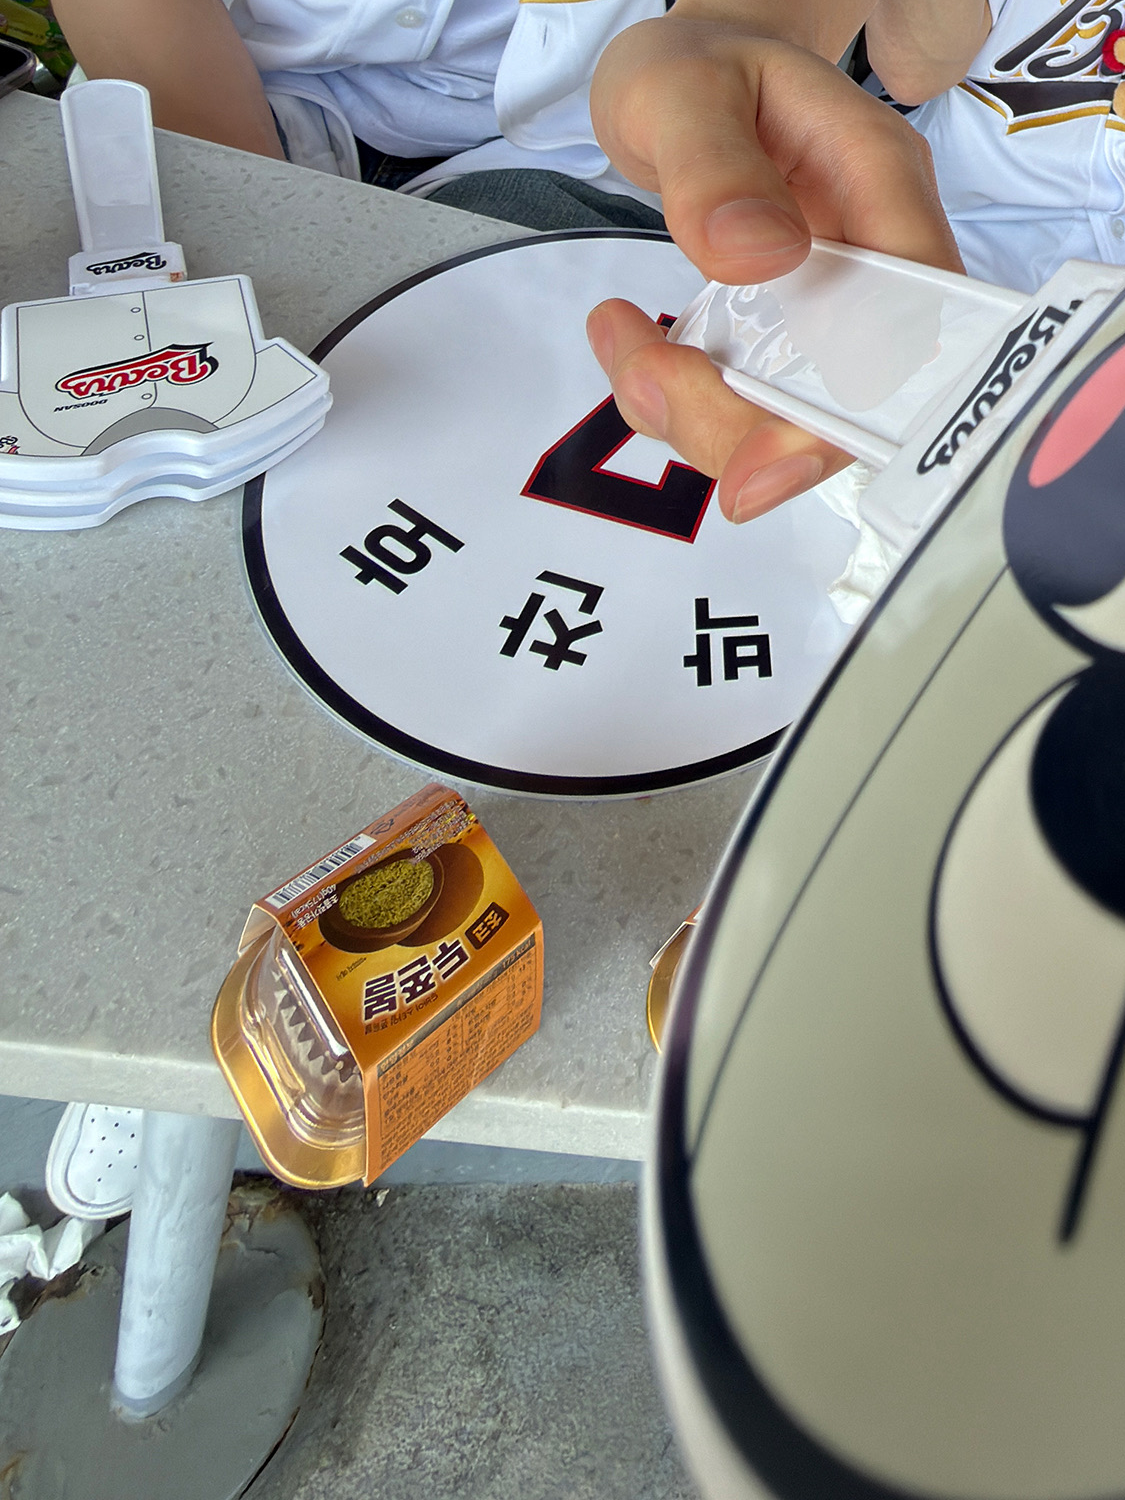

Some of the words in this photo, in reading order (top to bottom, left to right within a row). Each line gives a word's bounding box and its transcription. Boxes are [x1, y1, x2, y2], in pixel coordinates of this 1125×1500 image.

[86, 252, 168, 276] Bears
[55, 342, 219, 400] Bears
[53, 398, 109, 414] DOOSAN
[472, 909, 502, 943] 초코
[363, 939, 470, 1022] 두쫀볼
